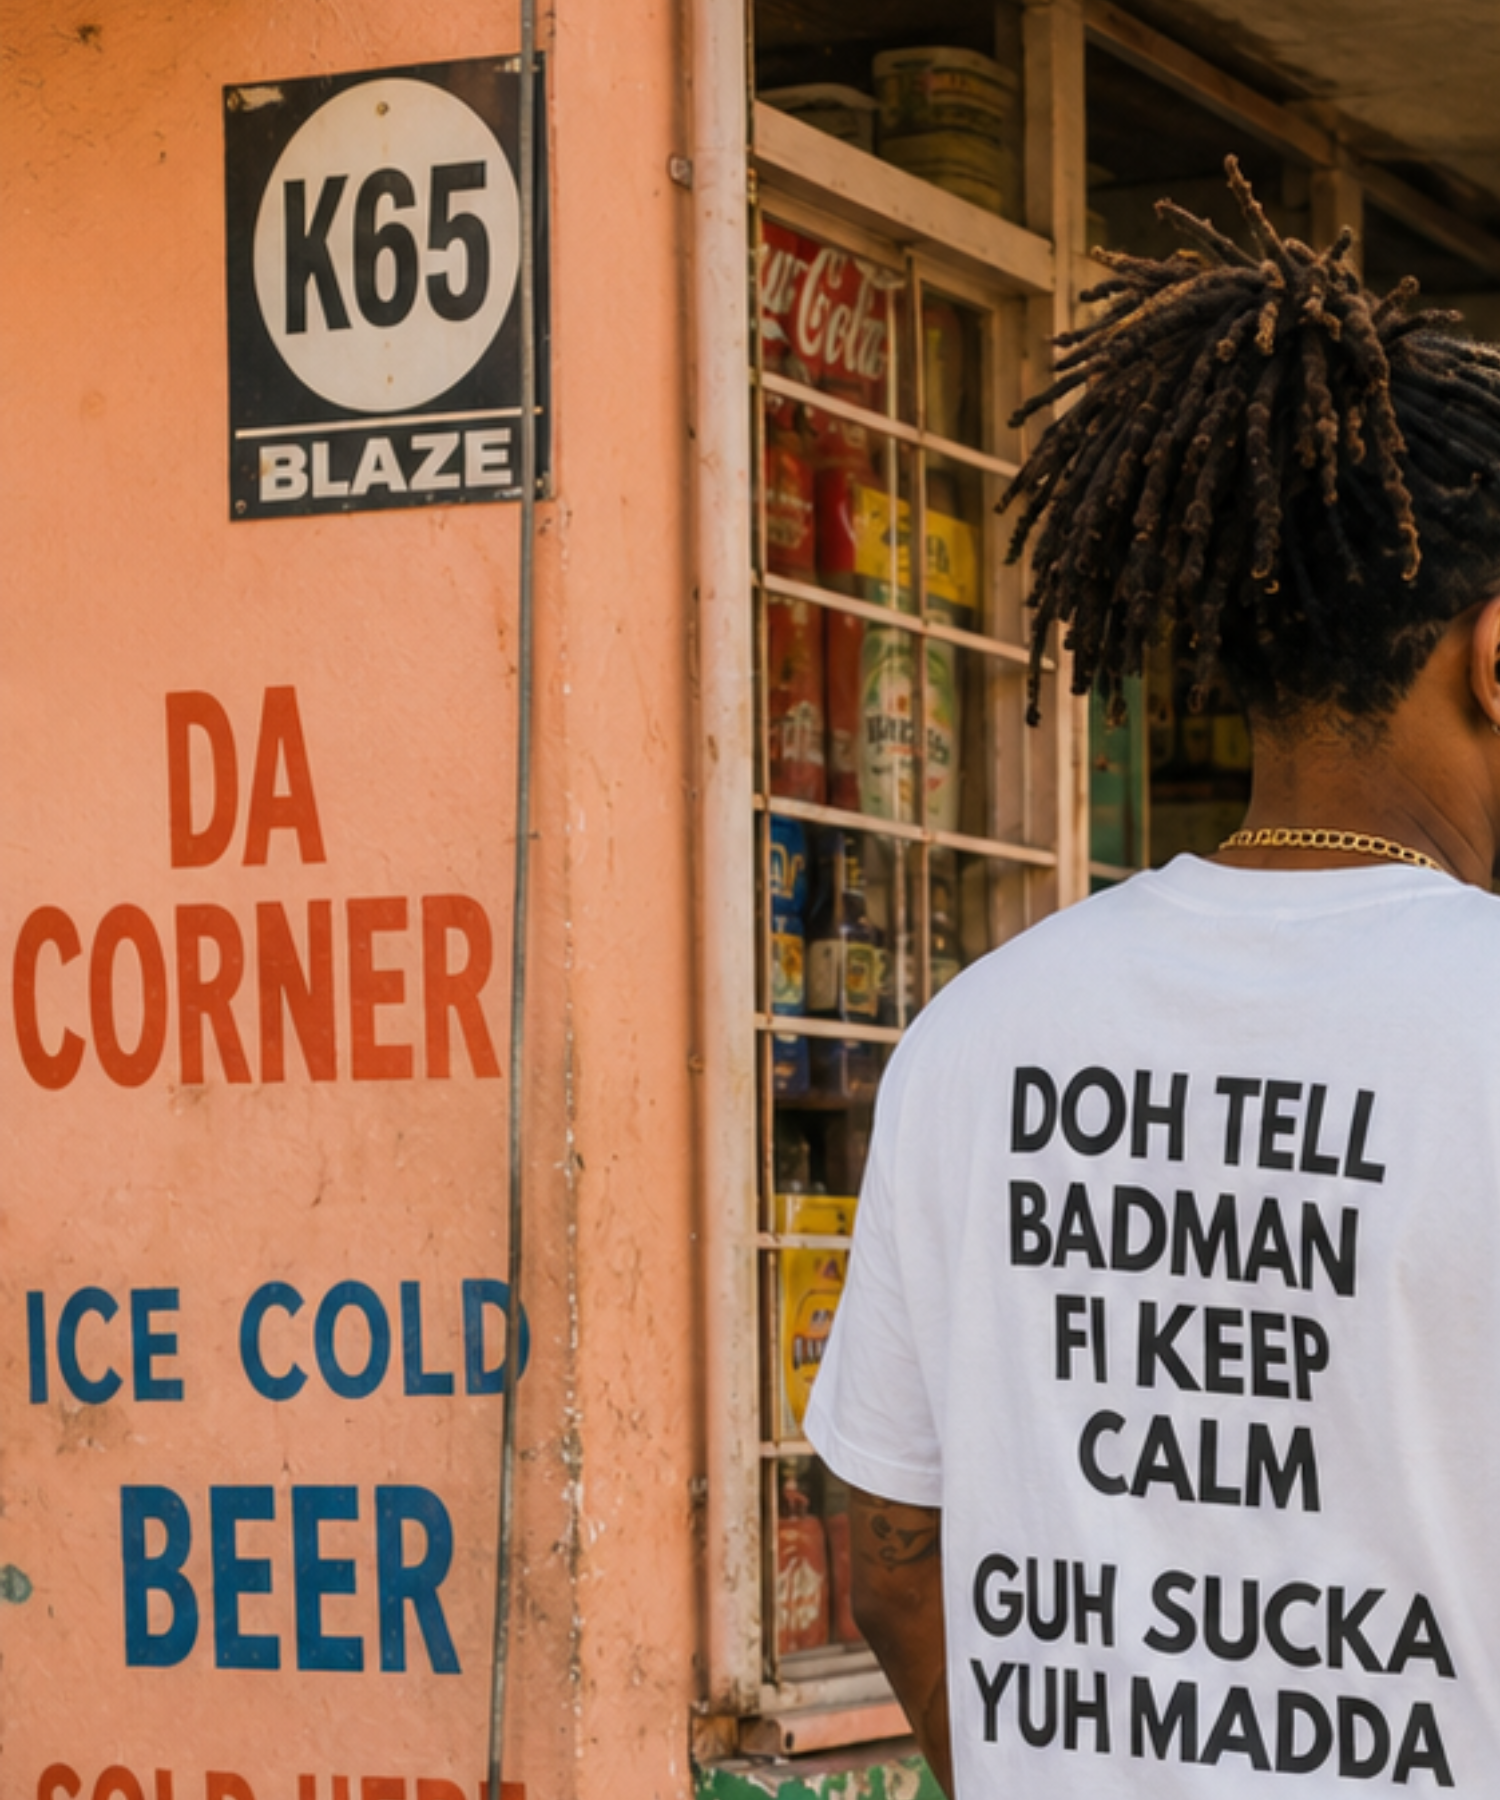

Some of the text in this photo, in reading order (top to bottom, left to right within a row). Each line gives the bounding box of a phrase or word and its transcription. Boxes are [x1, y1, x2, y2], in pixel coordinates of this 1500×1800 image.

[283, 160, 490, 335] K65
[258, 428, 512, 502] BLAZE
[165, 685, 326, 869] DA
[12, 893, 502, 1091] CORNER
[1010, 1065, 1386, 1184] DOH TELL
[1009, 1179, 1359, 1297] BADMAN
[26, 1278, 530, 1405] ICE COLD
[1054, 1294, 1330, 1402] FI KEEP
[1078, 1409, 1321, 1512] CALM
[120, 1484, 462, 1674] BEER
[973, 1553, 1457, 1680] GUH SUCKA
[970, 1658, 1455, 1789] YUH MADDA
